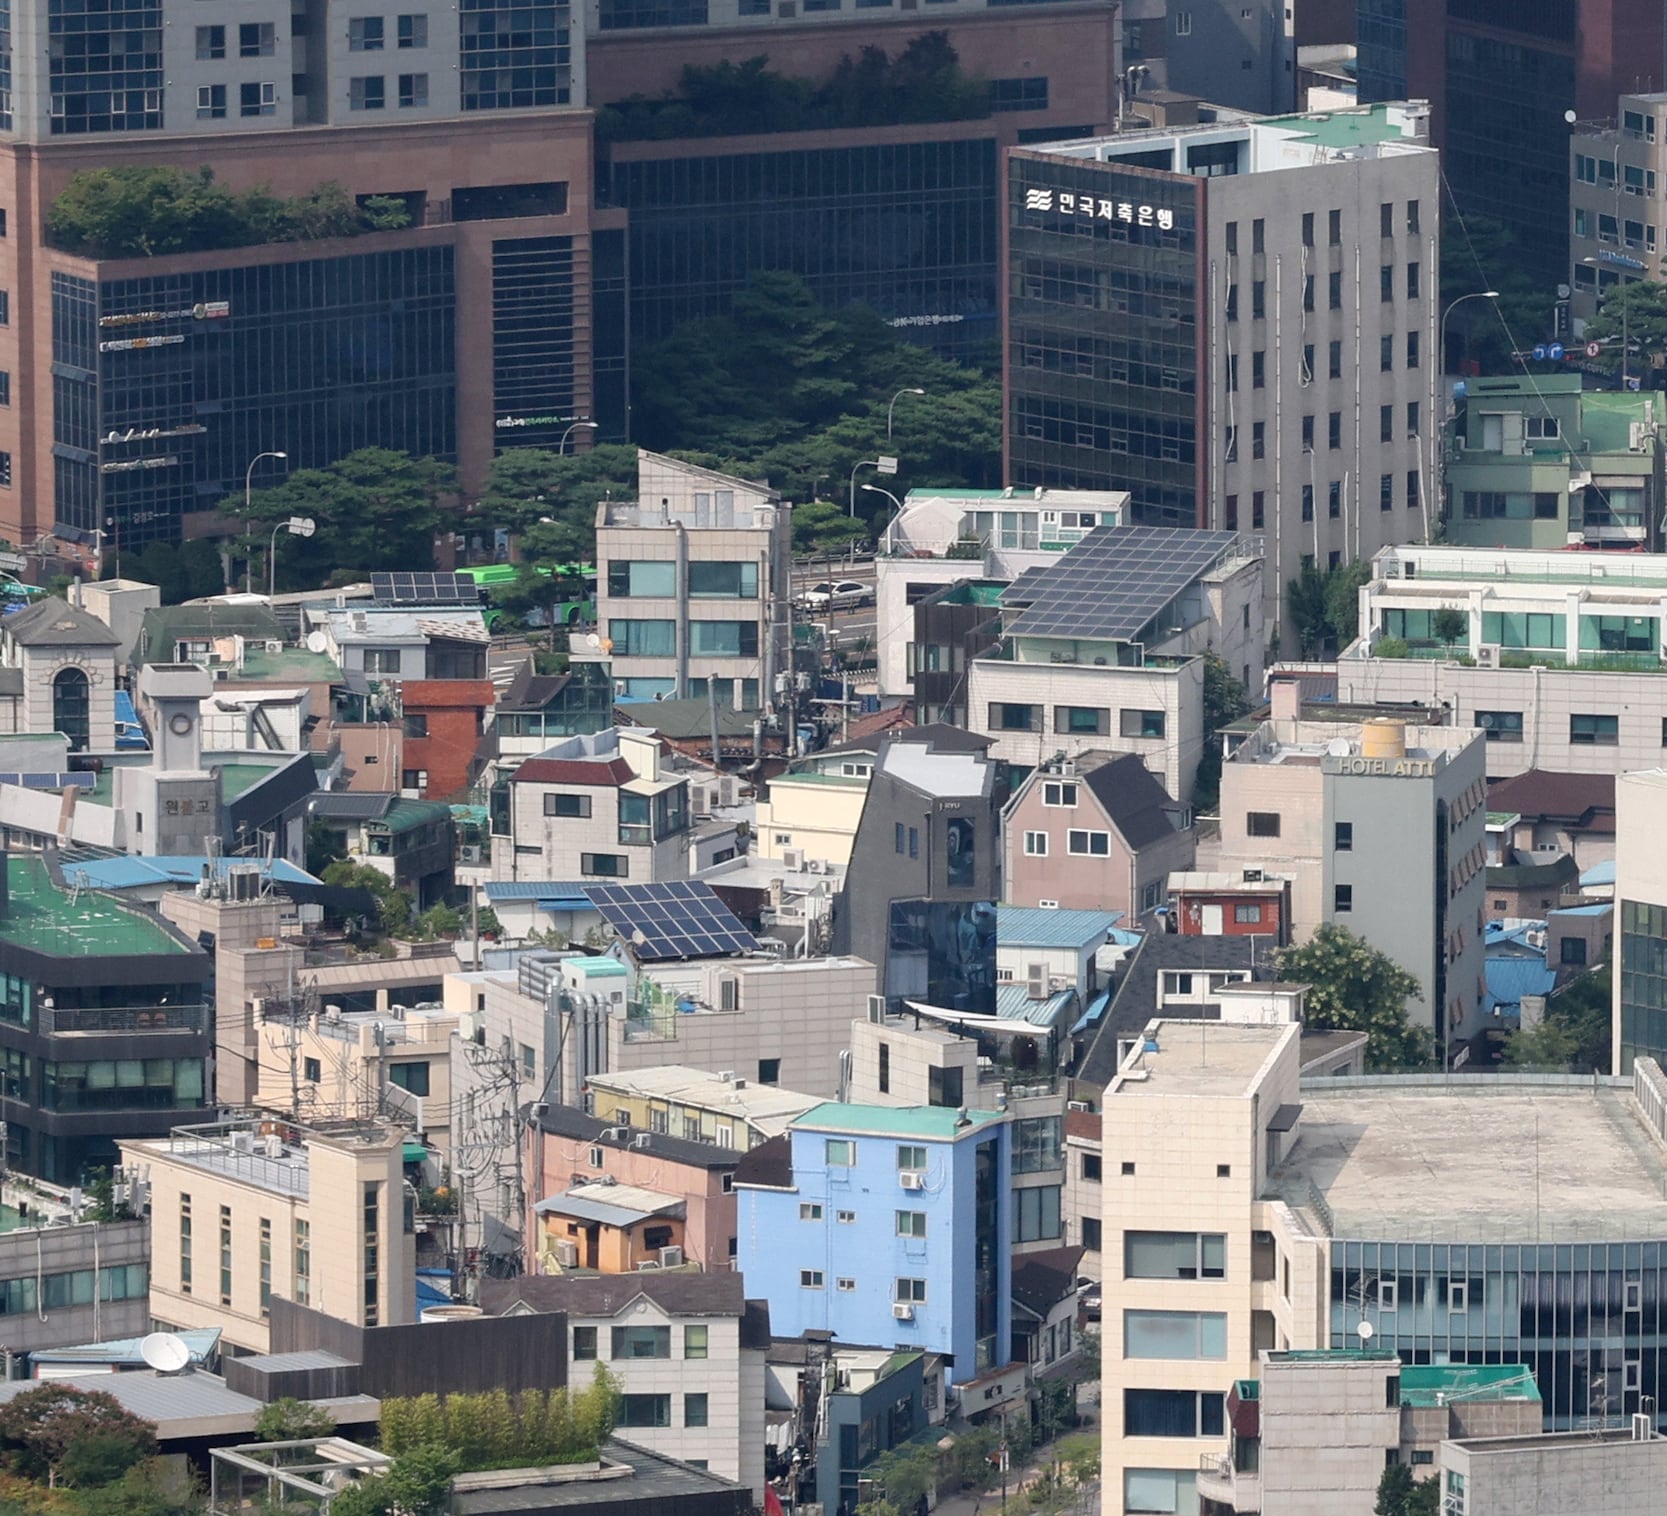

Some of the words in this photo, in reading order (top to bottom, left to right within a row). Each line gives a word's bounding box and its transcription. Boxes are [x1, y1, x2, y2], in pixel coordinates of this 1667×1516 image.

[1059, 193, 1174, 230] 민국저축은행
[1338, 757, 1391, 775] HOTEL
[1391, 759, 1435, 777] ATTI
